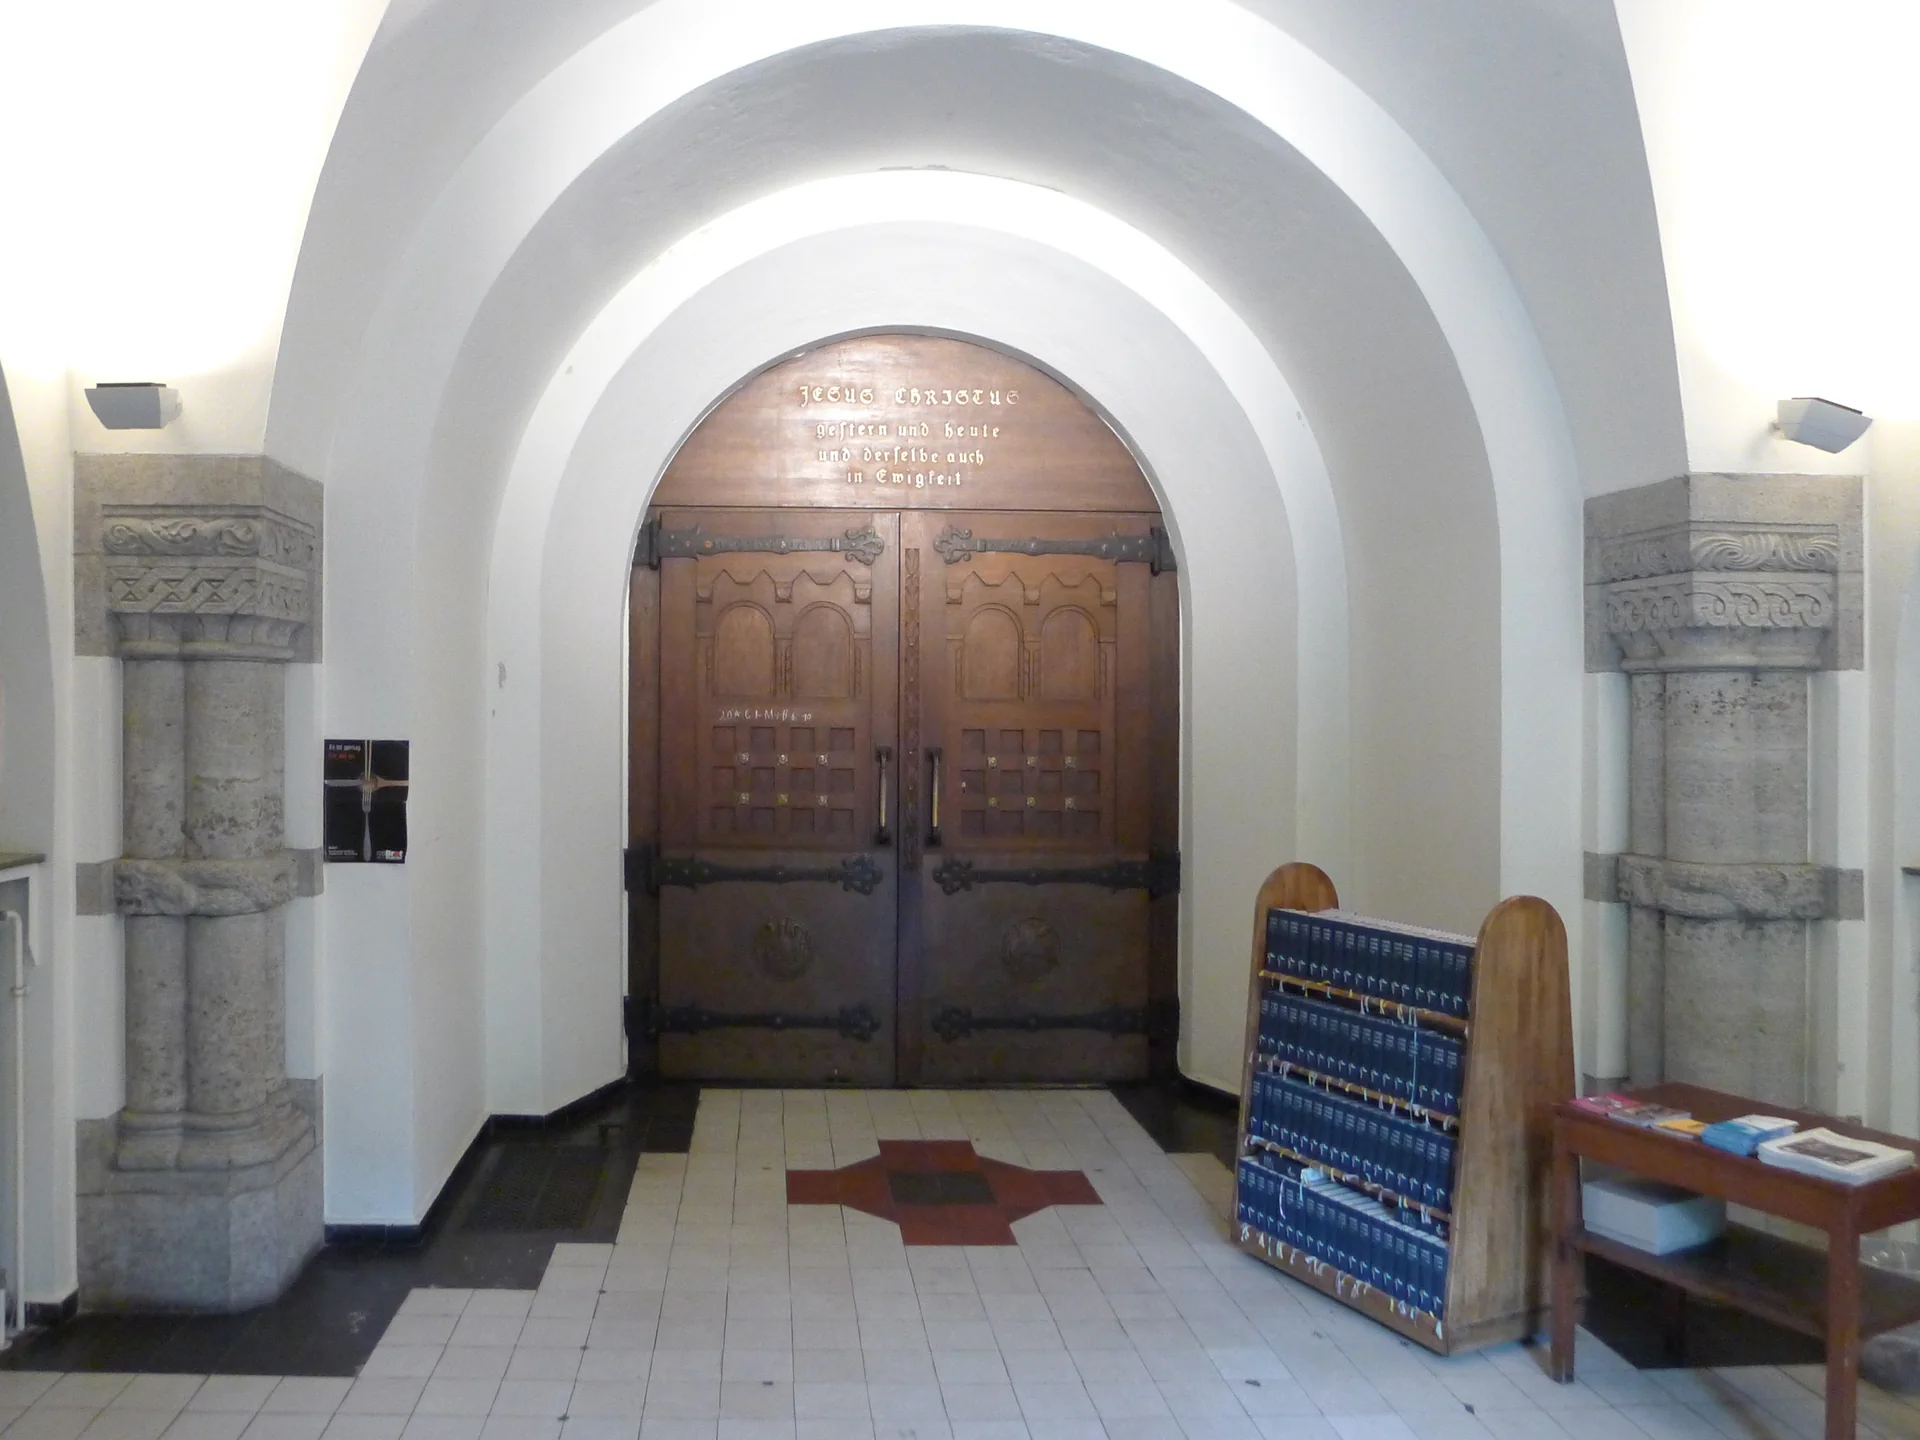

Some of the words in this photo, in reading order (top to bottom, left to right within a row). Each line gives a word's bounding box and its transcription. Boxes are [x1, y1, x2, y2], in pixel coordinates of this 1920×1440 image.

[799, 385, 874, 407] JESUS
[895, 386, 1020, 406] CHRISTUS
[898, 423, 930, 438] und
[944, 421, 1001, 440] heute
[818, 447, 851, 463] und
[946, 448, 984, 466] auch
[847, 470, 863, 484] in
[875, 468, 962, 489] Ewigkeit
